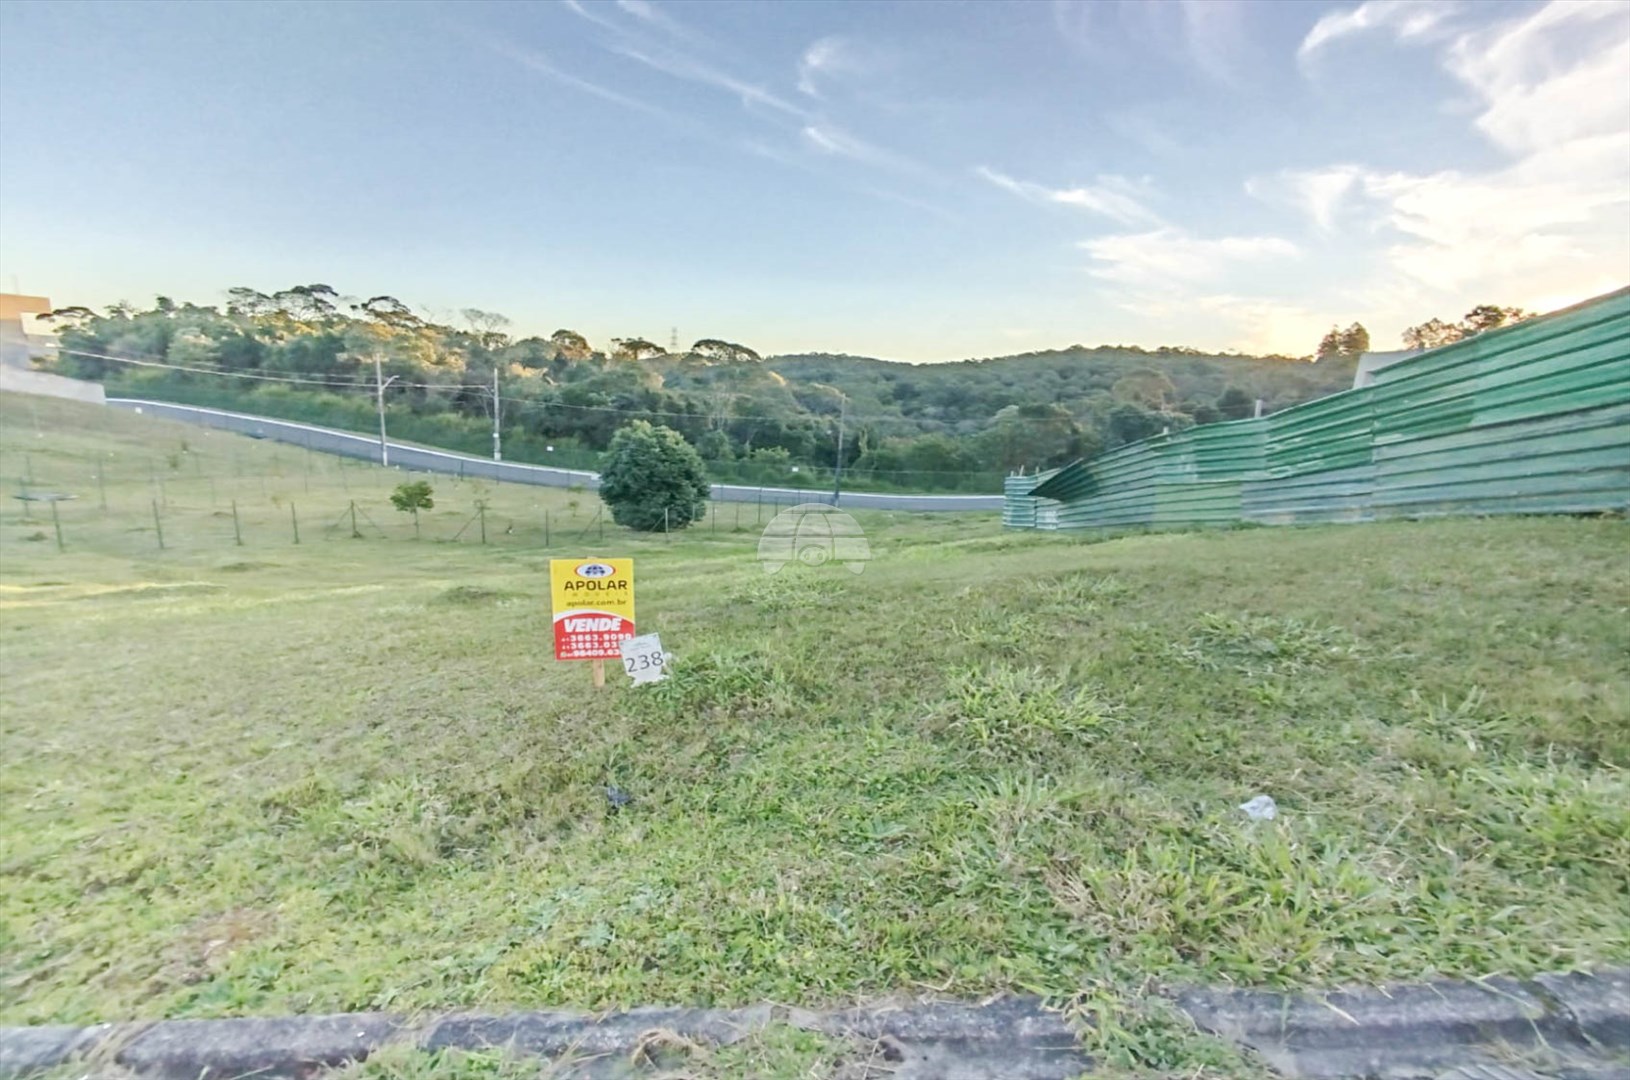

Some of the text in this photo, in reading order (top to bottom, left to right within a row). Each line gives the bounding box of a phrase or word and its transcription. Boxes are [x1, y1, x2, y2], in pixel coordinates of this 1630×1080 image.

[564, 580, 628, 591] APOLAR
[566, 598, 627, 608] apolar.com.br
[564, 618, 622, 633] VENDE
[571, 641, 617, 649] 3663.03
[625, 651, 664, 673] 238
